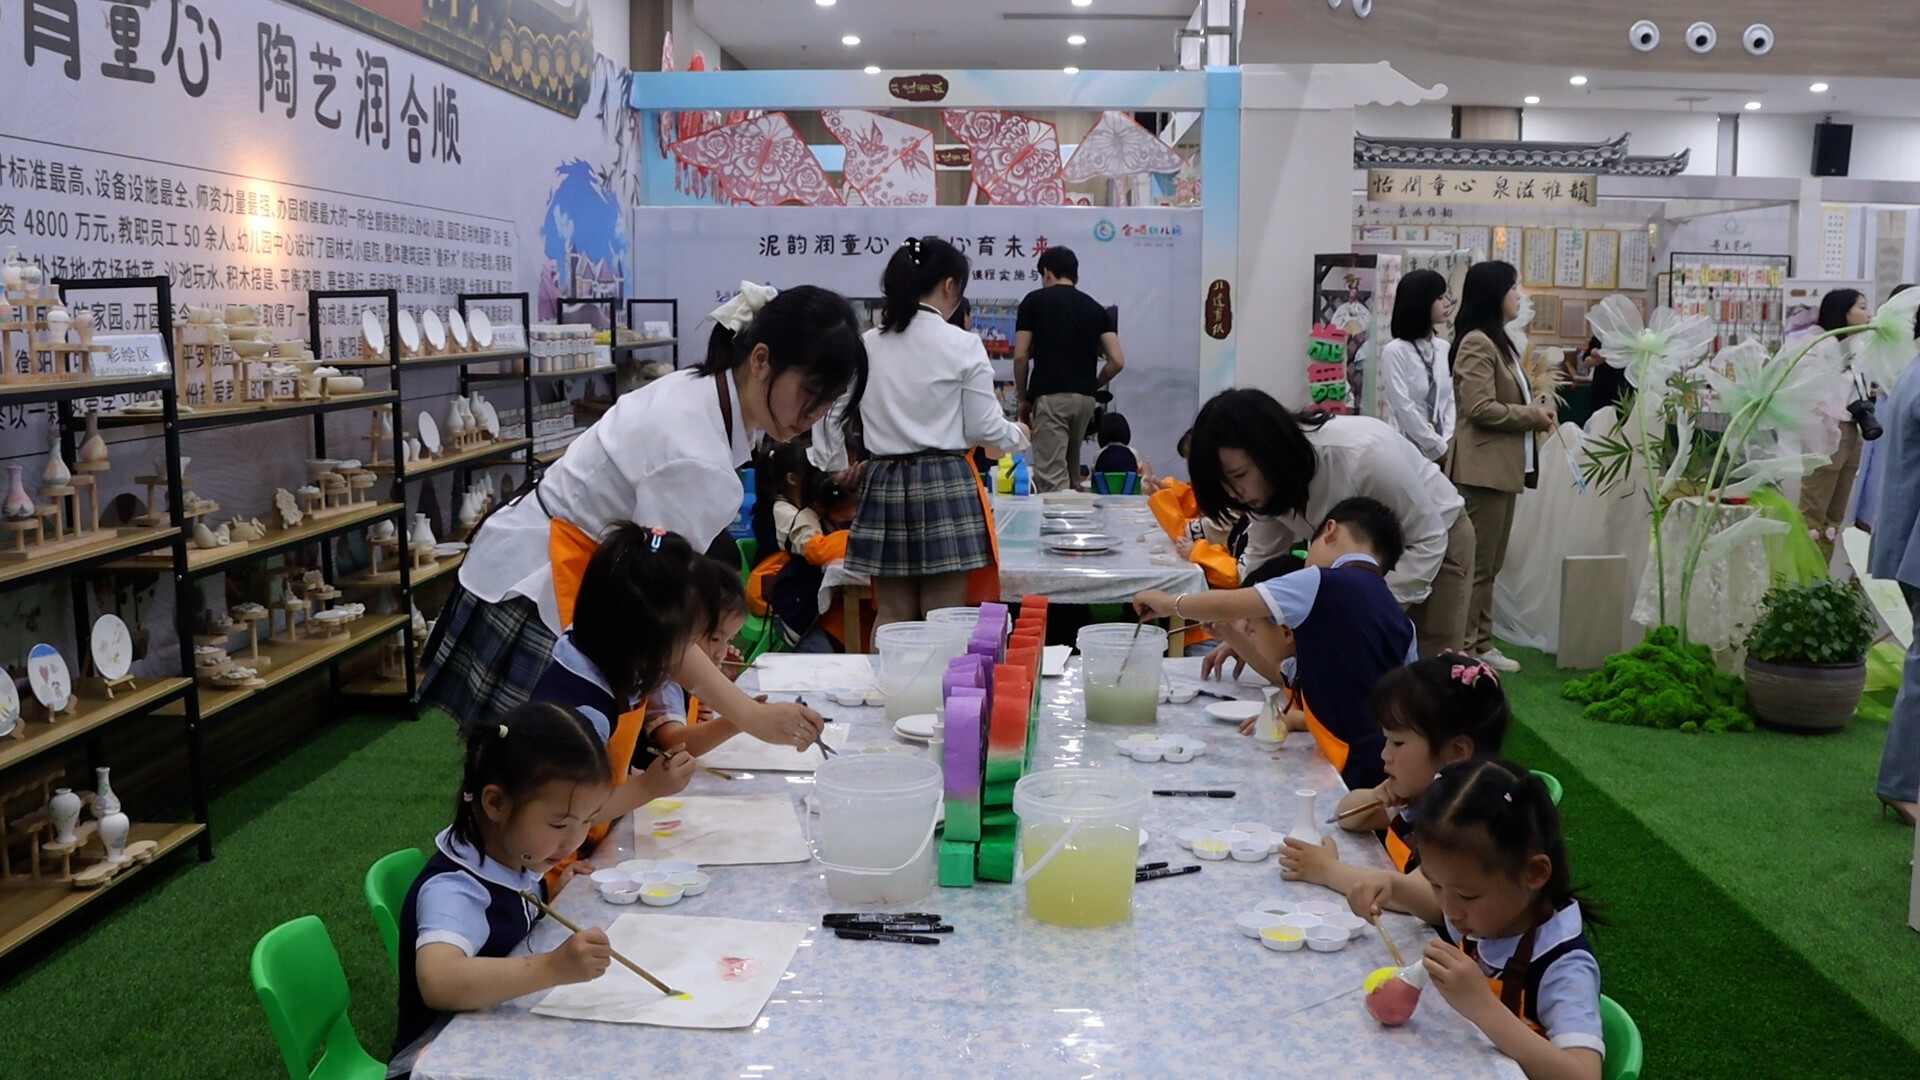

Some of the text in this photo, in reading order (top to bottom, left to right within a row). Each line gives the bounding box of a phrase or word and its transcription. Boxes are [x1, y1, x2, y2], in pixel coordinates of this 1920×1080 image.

[257, 22, 462, 165] 陶艺润合顺
[24, 208, 68, 238] 4800
[184, 224, 200, 248] 50
[759, 234, 890, 257] 泥韵润童心
